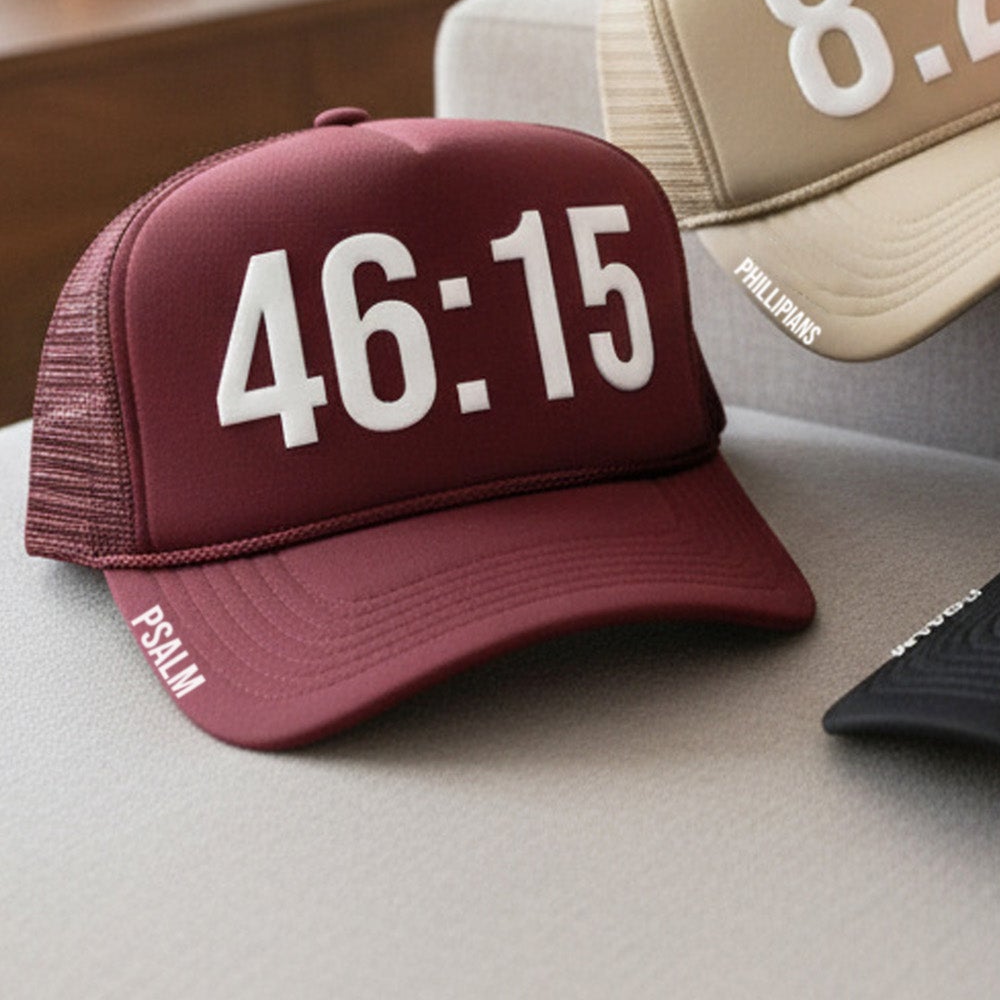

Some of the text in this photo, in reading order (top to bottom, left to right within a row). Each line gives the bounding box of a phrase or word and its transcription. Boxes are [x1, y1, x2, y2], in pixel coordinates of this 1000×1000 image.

[215, 204, 656, 449] 46:15
[733, 256, 822, 345] PHILLIPIANS
[130, 604, 206, 699] PSALM
